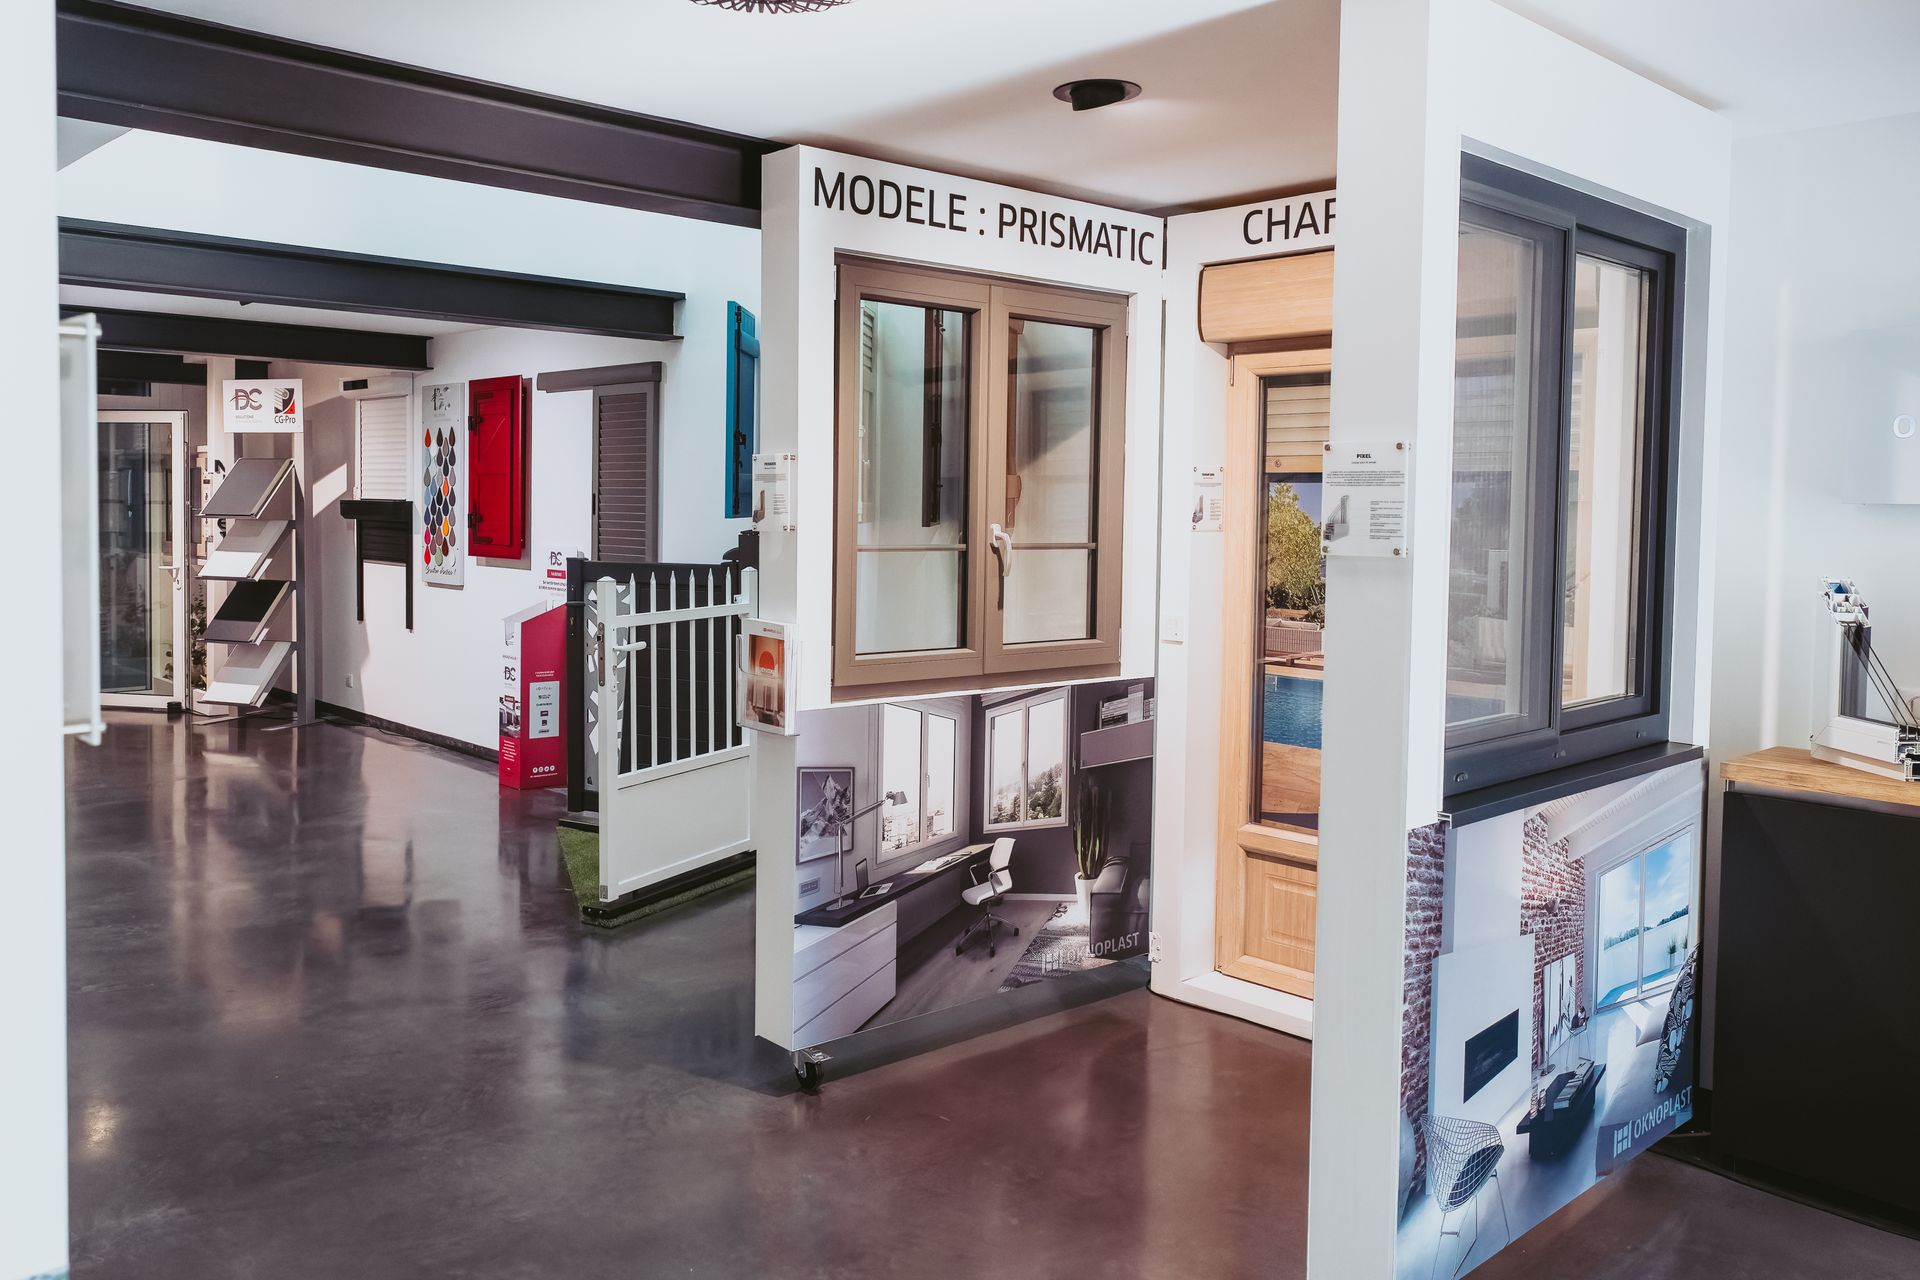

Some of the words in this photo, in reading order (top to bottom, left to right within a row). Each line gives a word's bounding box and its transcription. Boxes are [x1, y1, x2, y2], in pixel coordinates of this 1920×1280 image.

[814, 166, 967, 232] MODELE
[998, 202, 1154, 265] PRISMATIC
[1633, 1084, 1693, 1139] OKNOPLAST
